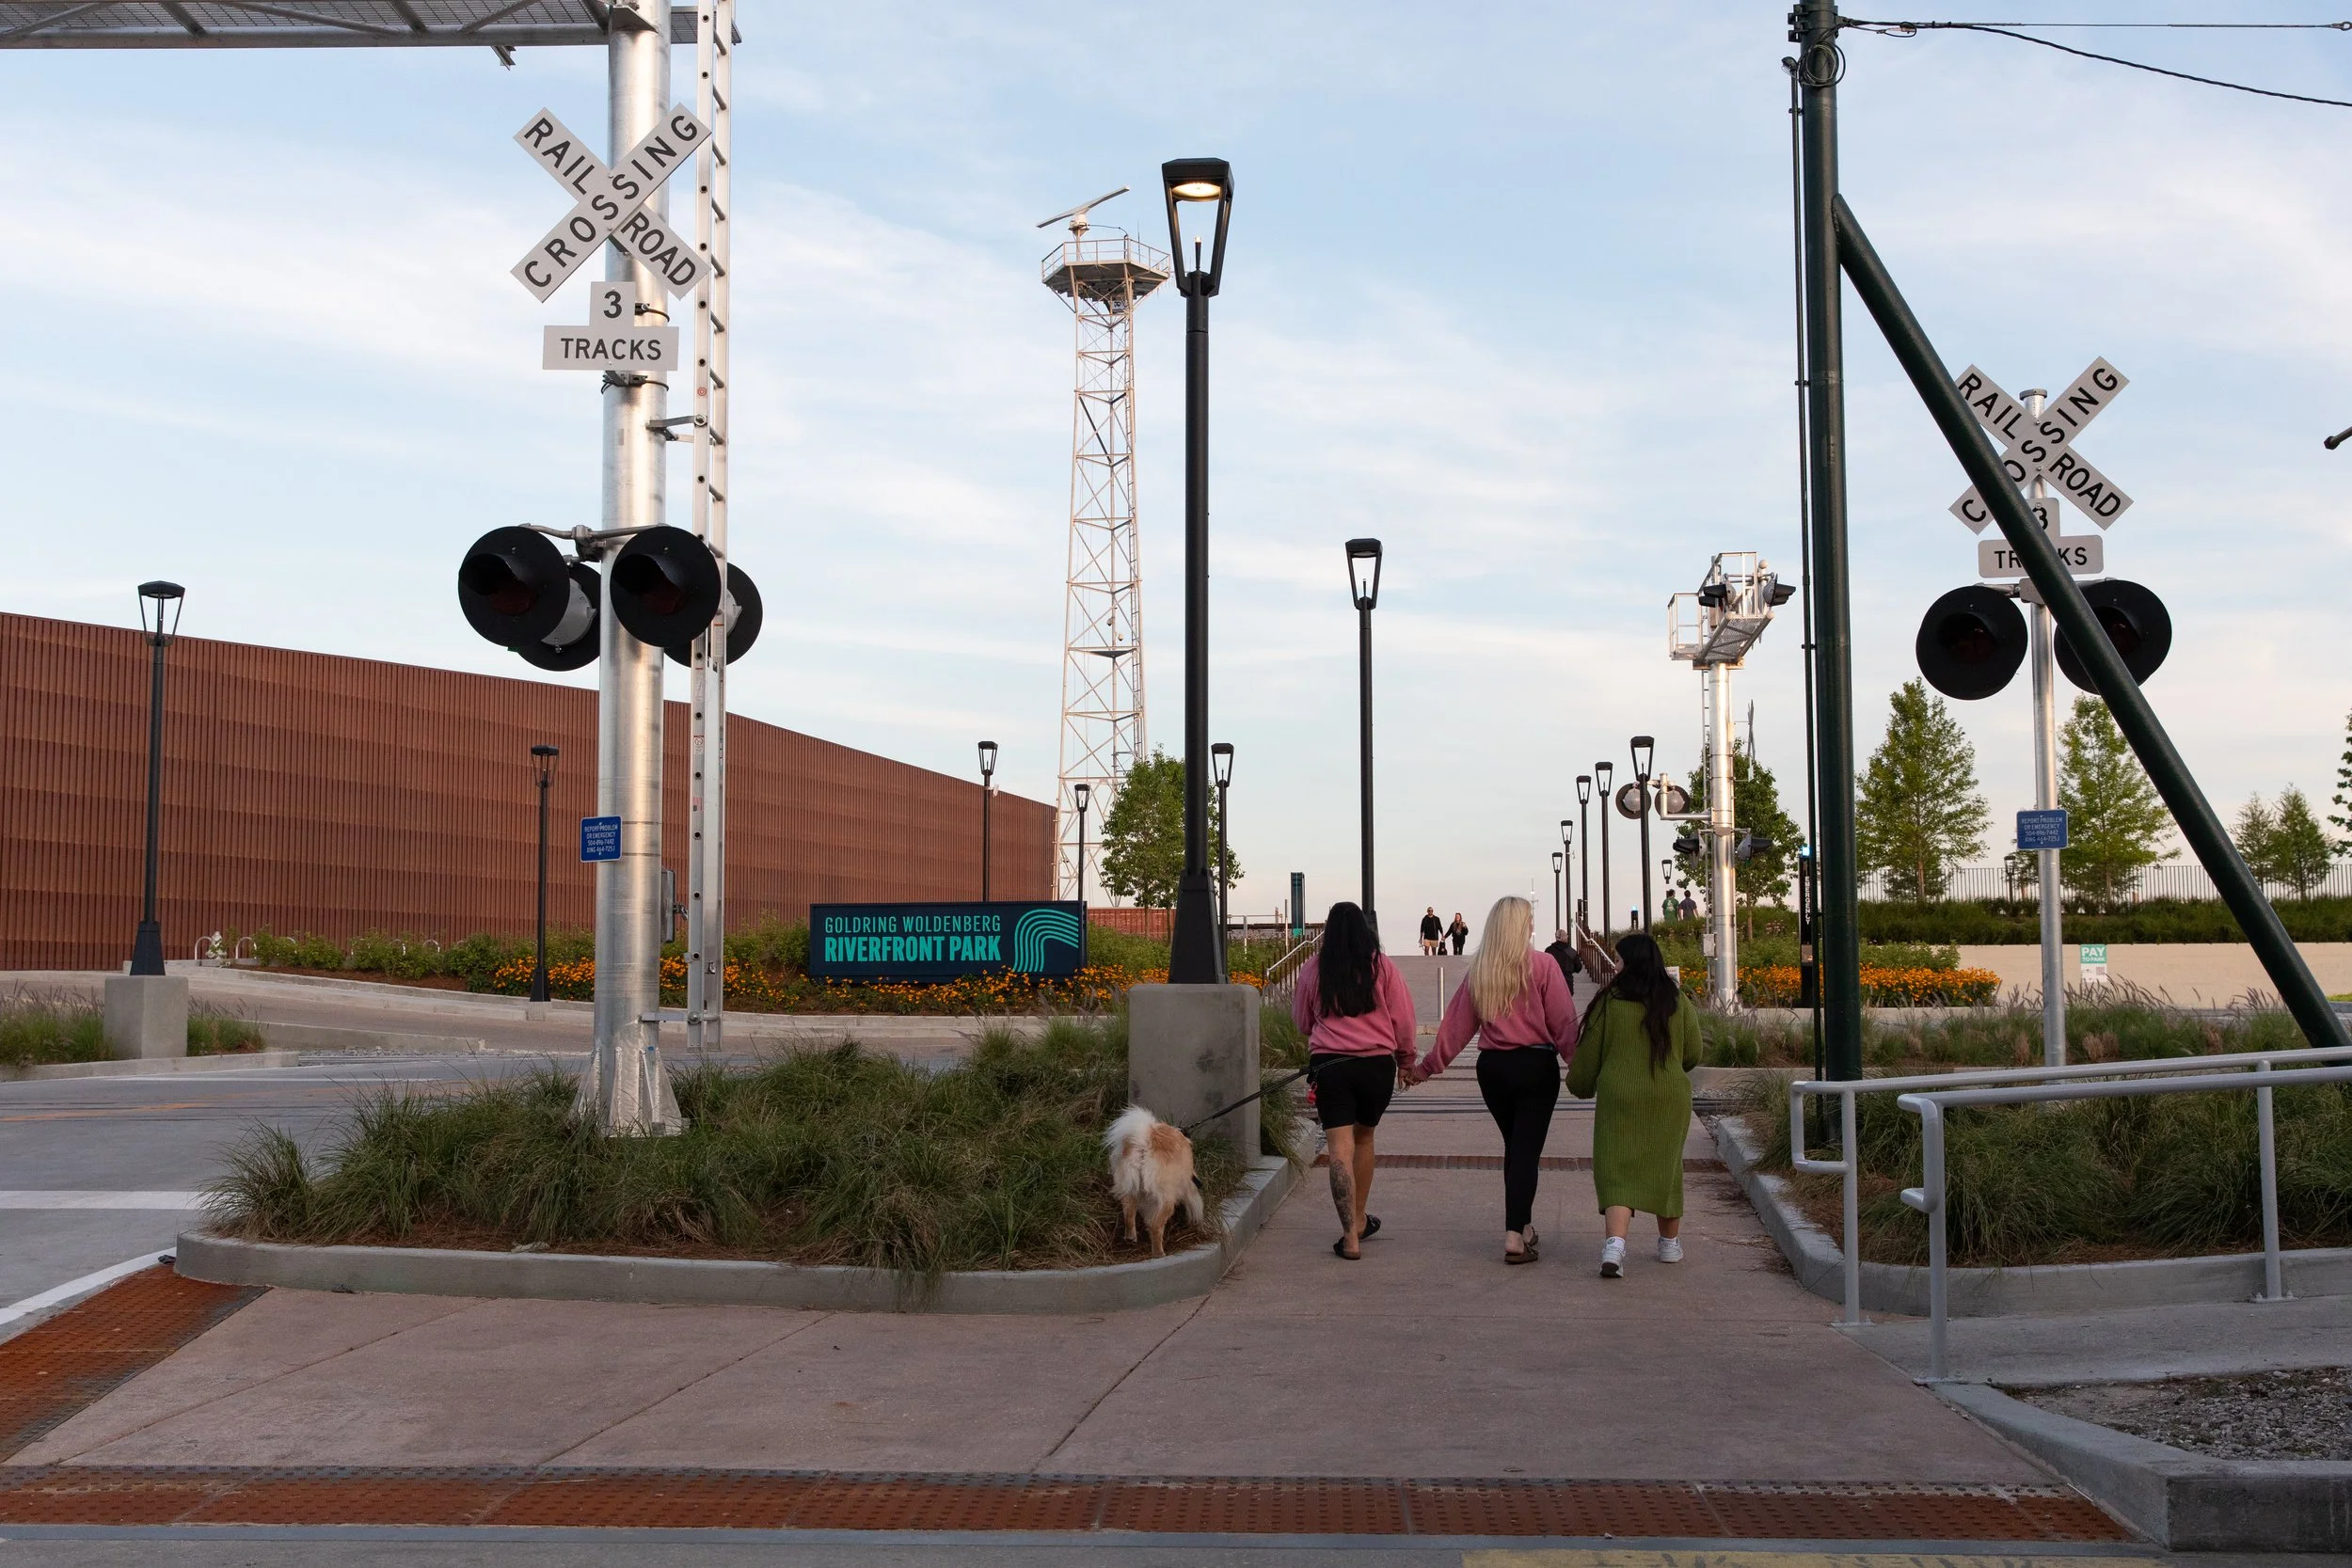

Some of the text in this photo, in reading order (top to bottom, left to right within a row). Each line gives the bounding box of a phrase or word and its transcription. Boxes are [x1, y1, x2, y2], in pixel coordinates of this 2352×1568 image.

[523, 117, 696, 286] RAIL ROAD
[524, 114, 698, 288] CROSSING
[603, 291, 622, 319] 3
[560, 338, 661, 360] TRACKS
[1958, 372, 2121, 518] RAIL ROAD
[1961, 368, 2118, 523] COSSING
[2032, 506, 2048, 530] 3
[1994, 546, 2088, 568] TRKS
[825, 914, 1001, 933] GOLDRING WOLDENBERG
[824, 935, 1002, 962] RIVERFRONT PARK
[2081, 946, 2106, 957] PAY
